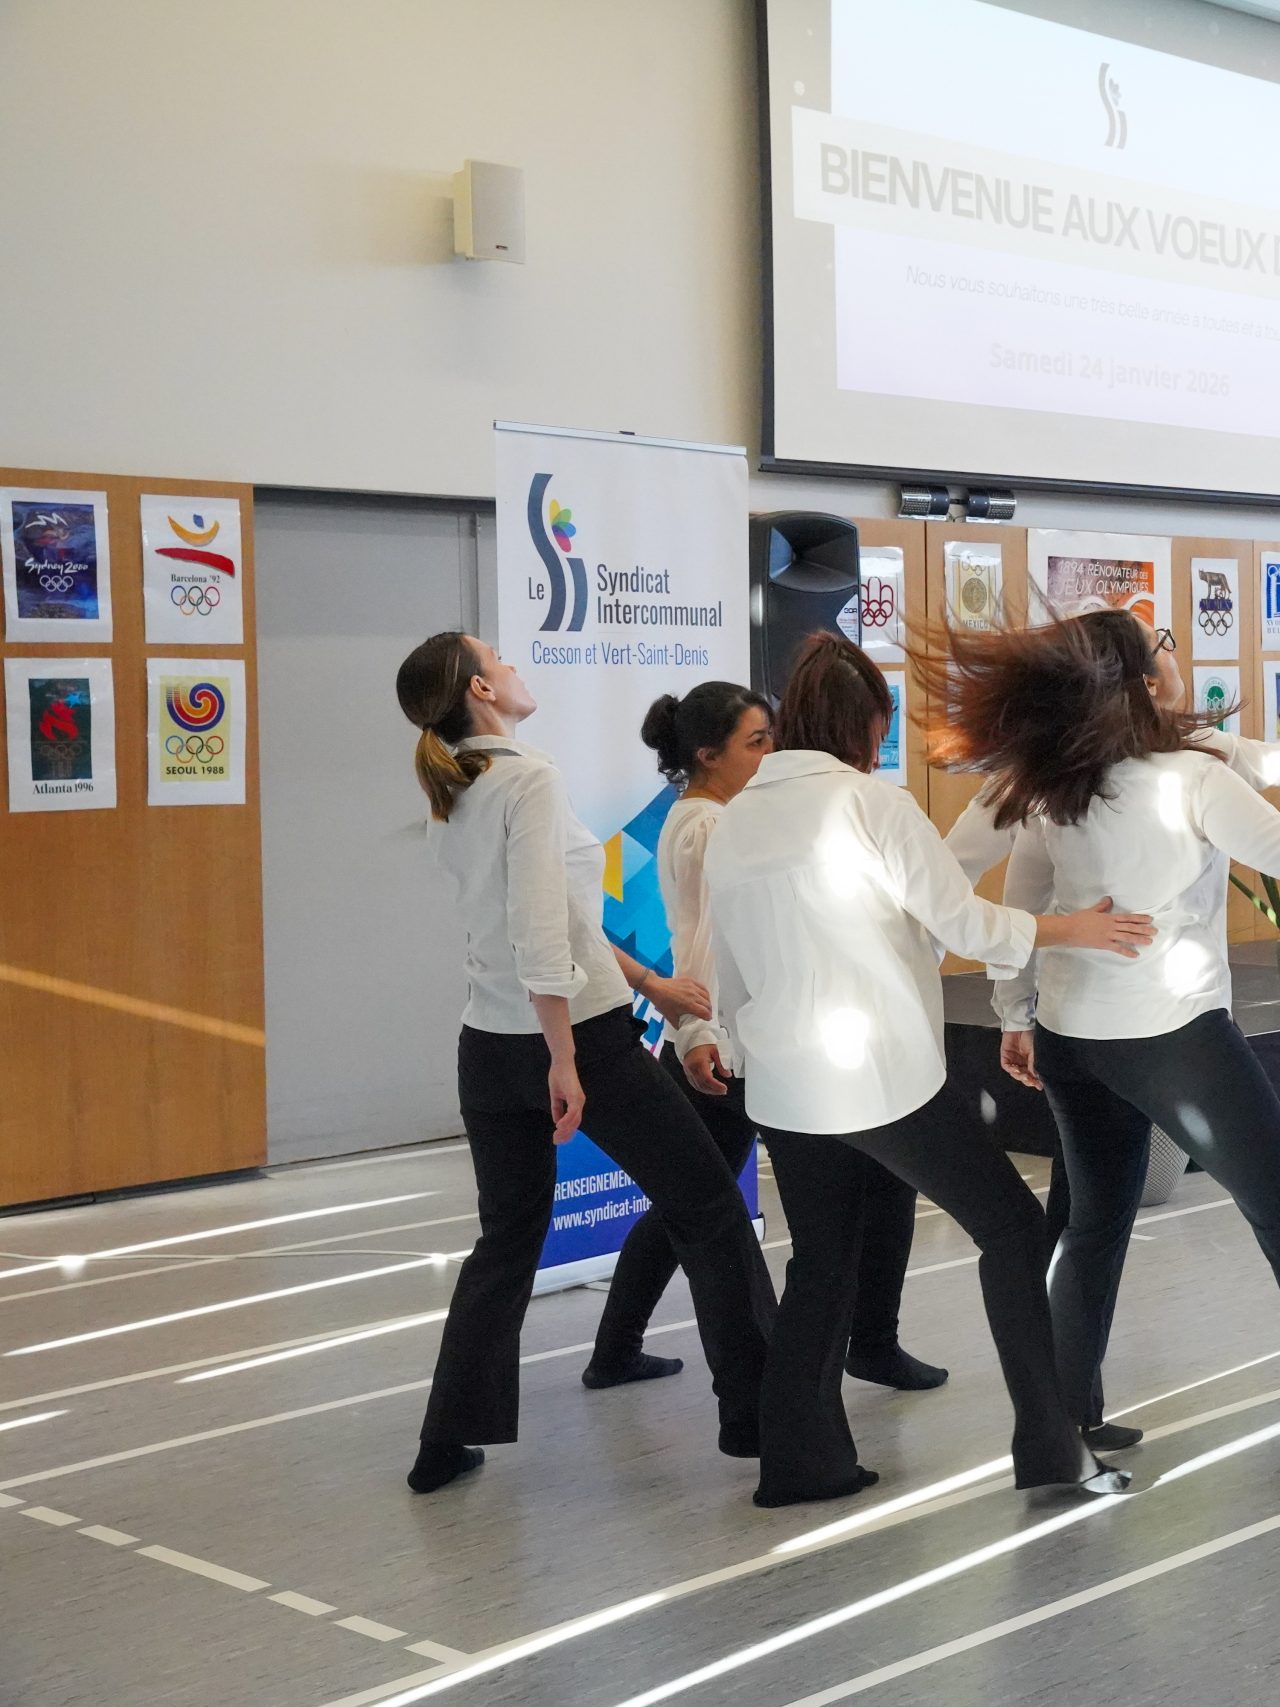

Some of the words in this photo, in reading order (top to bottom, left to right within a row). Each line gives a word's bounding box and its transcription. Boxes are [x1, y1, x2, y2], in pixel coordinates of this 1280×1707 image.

[820, 141, 1055, 235] BIENVENUE
[1061, 193, 1141, 252] AUX
[1146, 207, 1268, 275] VOEUX
[906, 263, 946, 288] Nous
[950, 273, 985, 294] vous
[988, 280, 1061, 306] souhaitons
[1064, 293, 1088, 311] une
[1091, 296, 1115, 315] très
[1118, 299, 1149, 320] belle
[1151, 306, 1190, 326] année
[1202, 313, 1240, 334] toutes
[989, 341, 1073, 377] Samedi
[1079, 353, 1104, 382] 24
[1107, 355, 1182, 390] janvier
[1185, 367, 1231, 398] 2026
[25, 557, 64, 575] Sydney
[64, 561, 88, 574] 2000
[1058, 560, 1084, 575] 1894
[1087, 562, 1138, 579] RÉNOVATEUR
[171, 574, 207, 583] Barcelona
[528, 576, 544, 600] Le
[597, 563, 670, 595] Syndicat
[1055, 577, 1093, 595] JEUX
[1096, 579, 1149, 594] OLYMPIQUES
[597, 596, 722, 627] Intercommunal
[532, 641, 582, 664] Cesson
[585, 644, 597, 664] et
[601, 641, 709, 666] Vert-Saint-Denis
[166, 766, 198, 775] SEOUL
[201, 766, 224, 775] 1988
[33, 783, 72, 795] Atlanta
[74, 782, 94, 793] 1996
[554, 1169, 635, 1201] RENSEIGNEMEN
